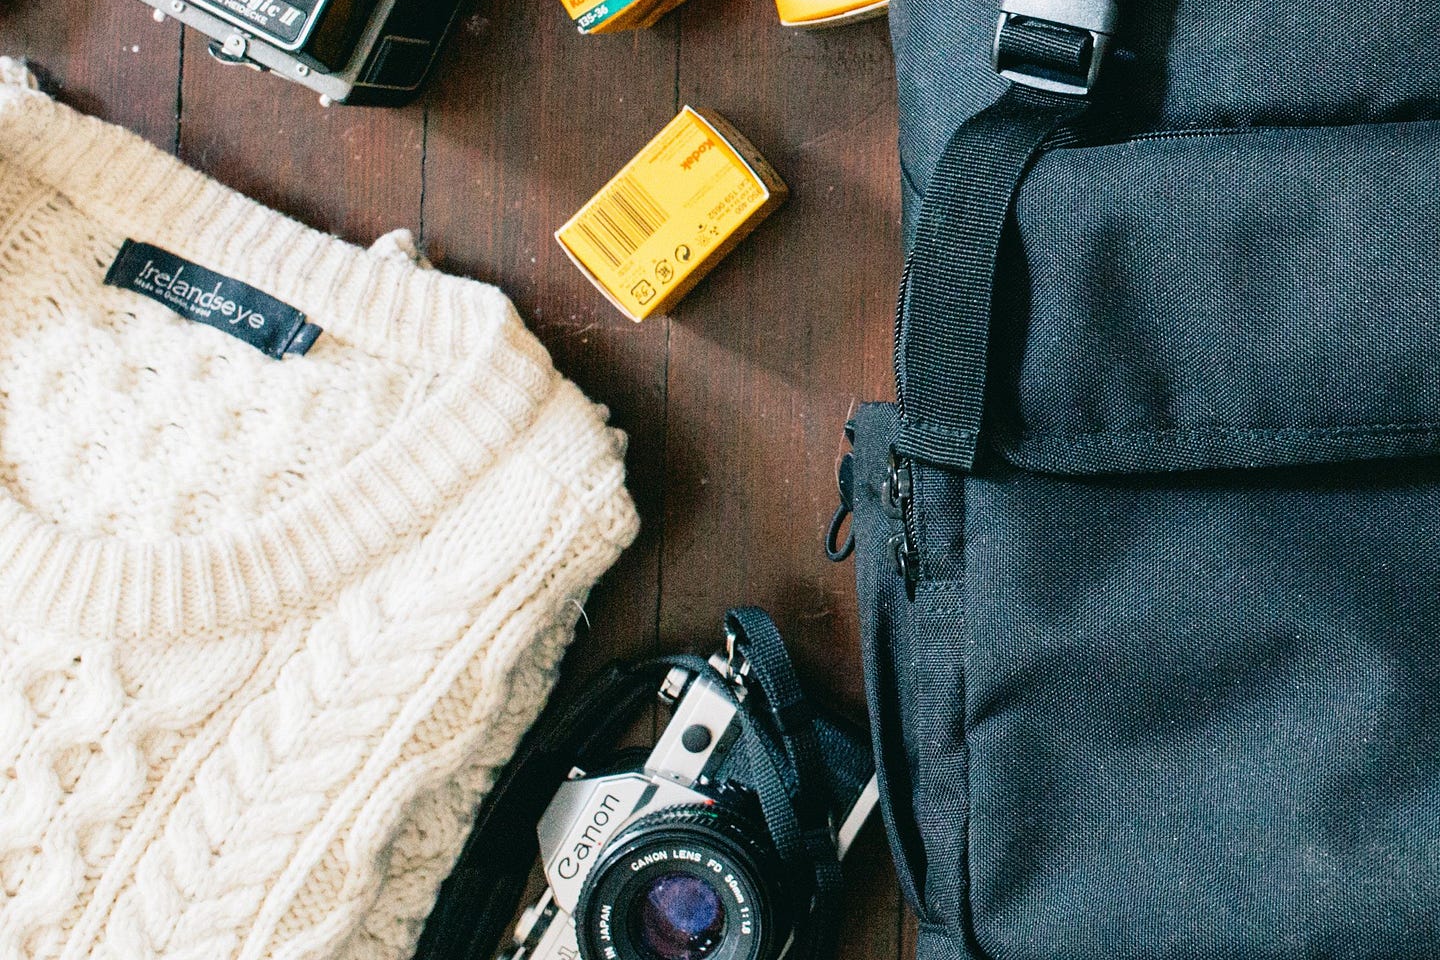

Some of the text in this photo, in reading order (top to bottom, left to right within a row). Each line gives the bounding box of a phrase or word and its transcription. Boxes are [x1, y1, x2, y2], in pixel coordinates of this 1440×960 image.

[578, 5, 609, 27] 135-36
[680, 137, 715, 171] Kodak
[137, 259, 265, 329] Irelandseye
[557, 791, 621, 882] Canon
[631, 851, 668, 872] CANON
[672, 850, 702, 862] LENS
[707, 858, 723, 873] FD
[724, 874, 745, 904] 50mm
[600, 904, 612, 941] JAPAN
